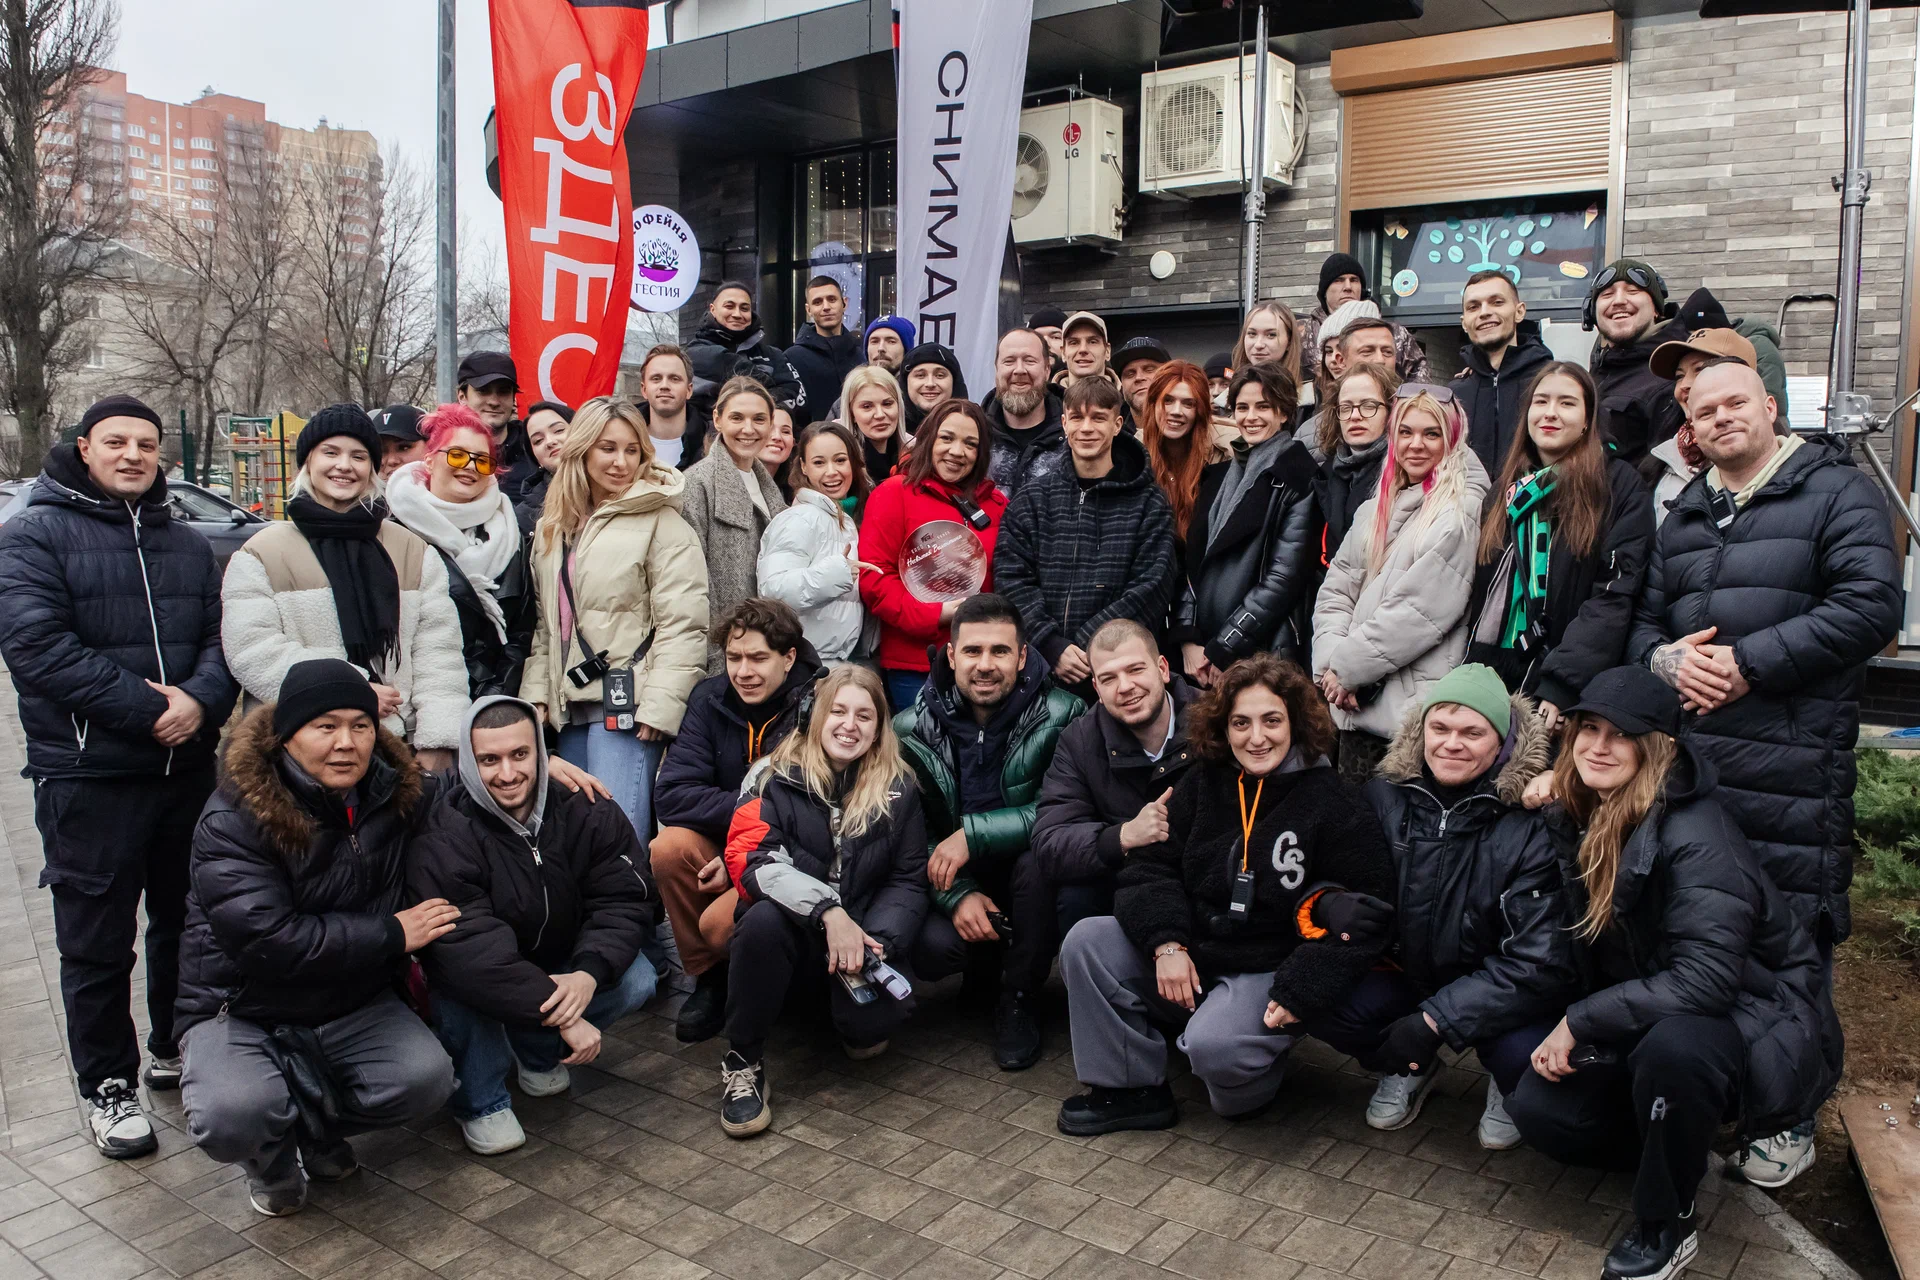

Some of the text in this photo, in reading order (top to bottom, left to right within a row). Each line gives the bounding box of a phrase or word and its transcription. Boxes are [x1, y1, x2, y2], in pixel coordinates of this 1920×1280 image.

[1065, 148, 1079, 159] LG
[919, 50, 968, 355] СНИМАЕ
[633, 213, 688, 244] ОФЕЙНЯ
[635, 283, 680, 298] ГЕСТИЯ
[382, 413, 392, 425] V
